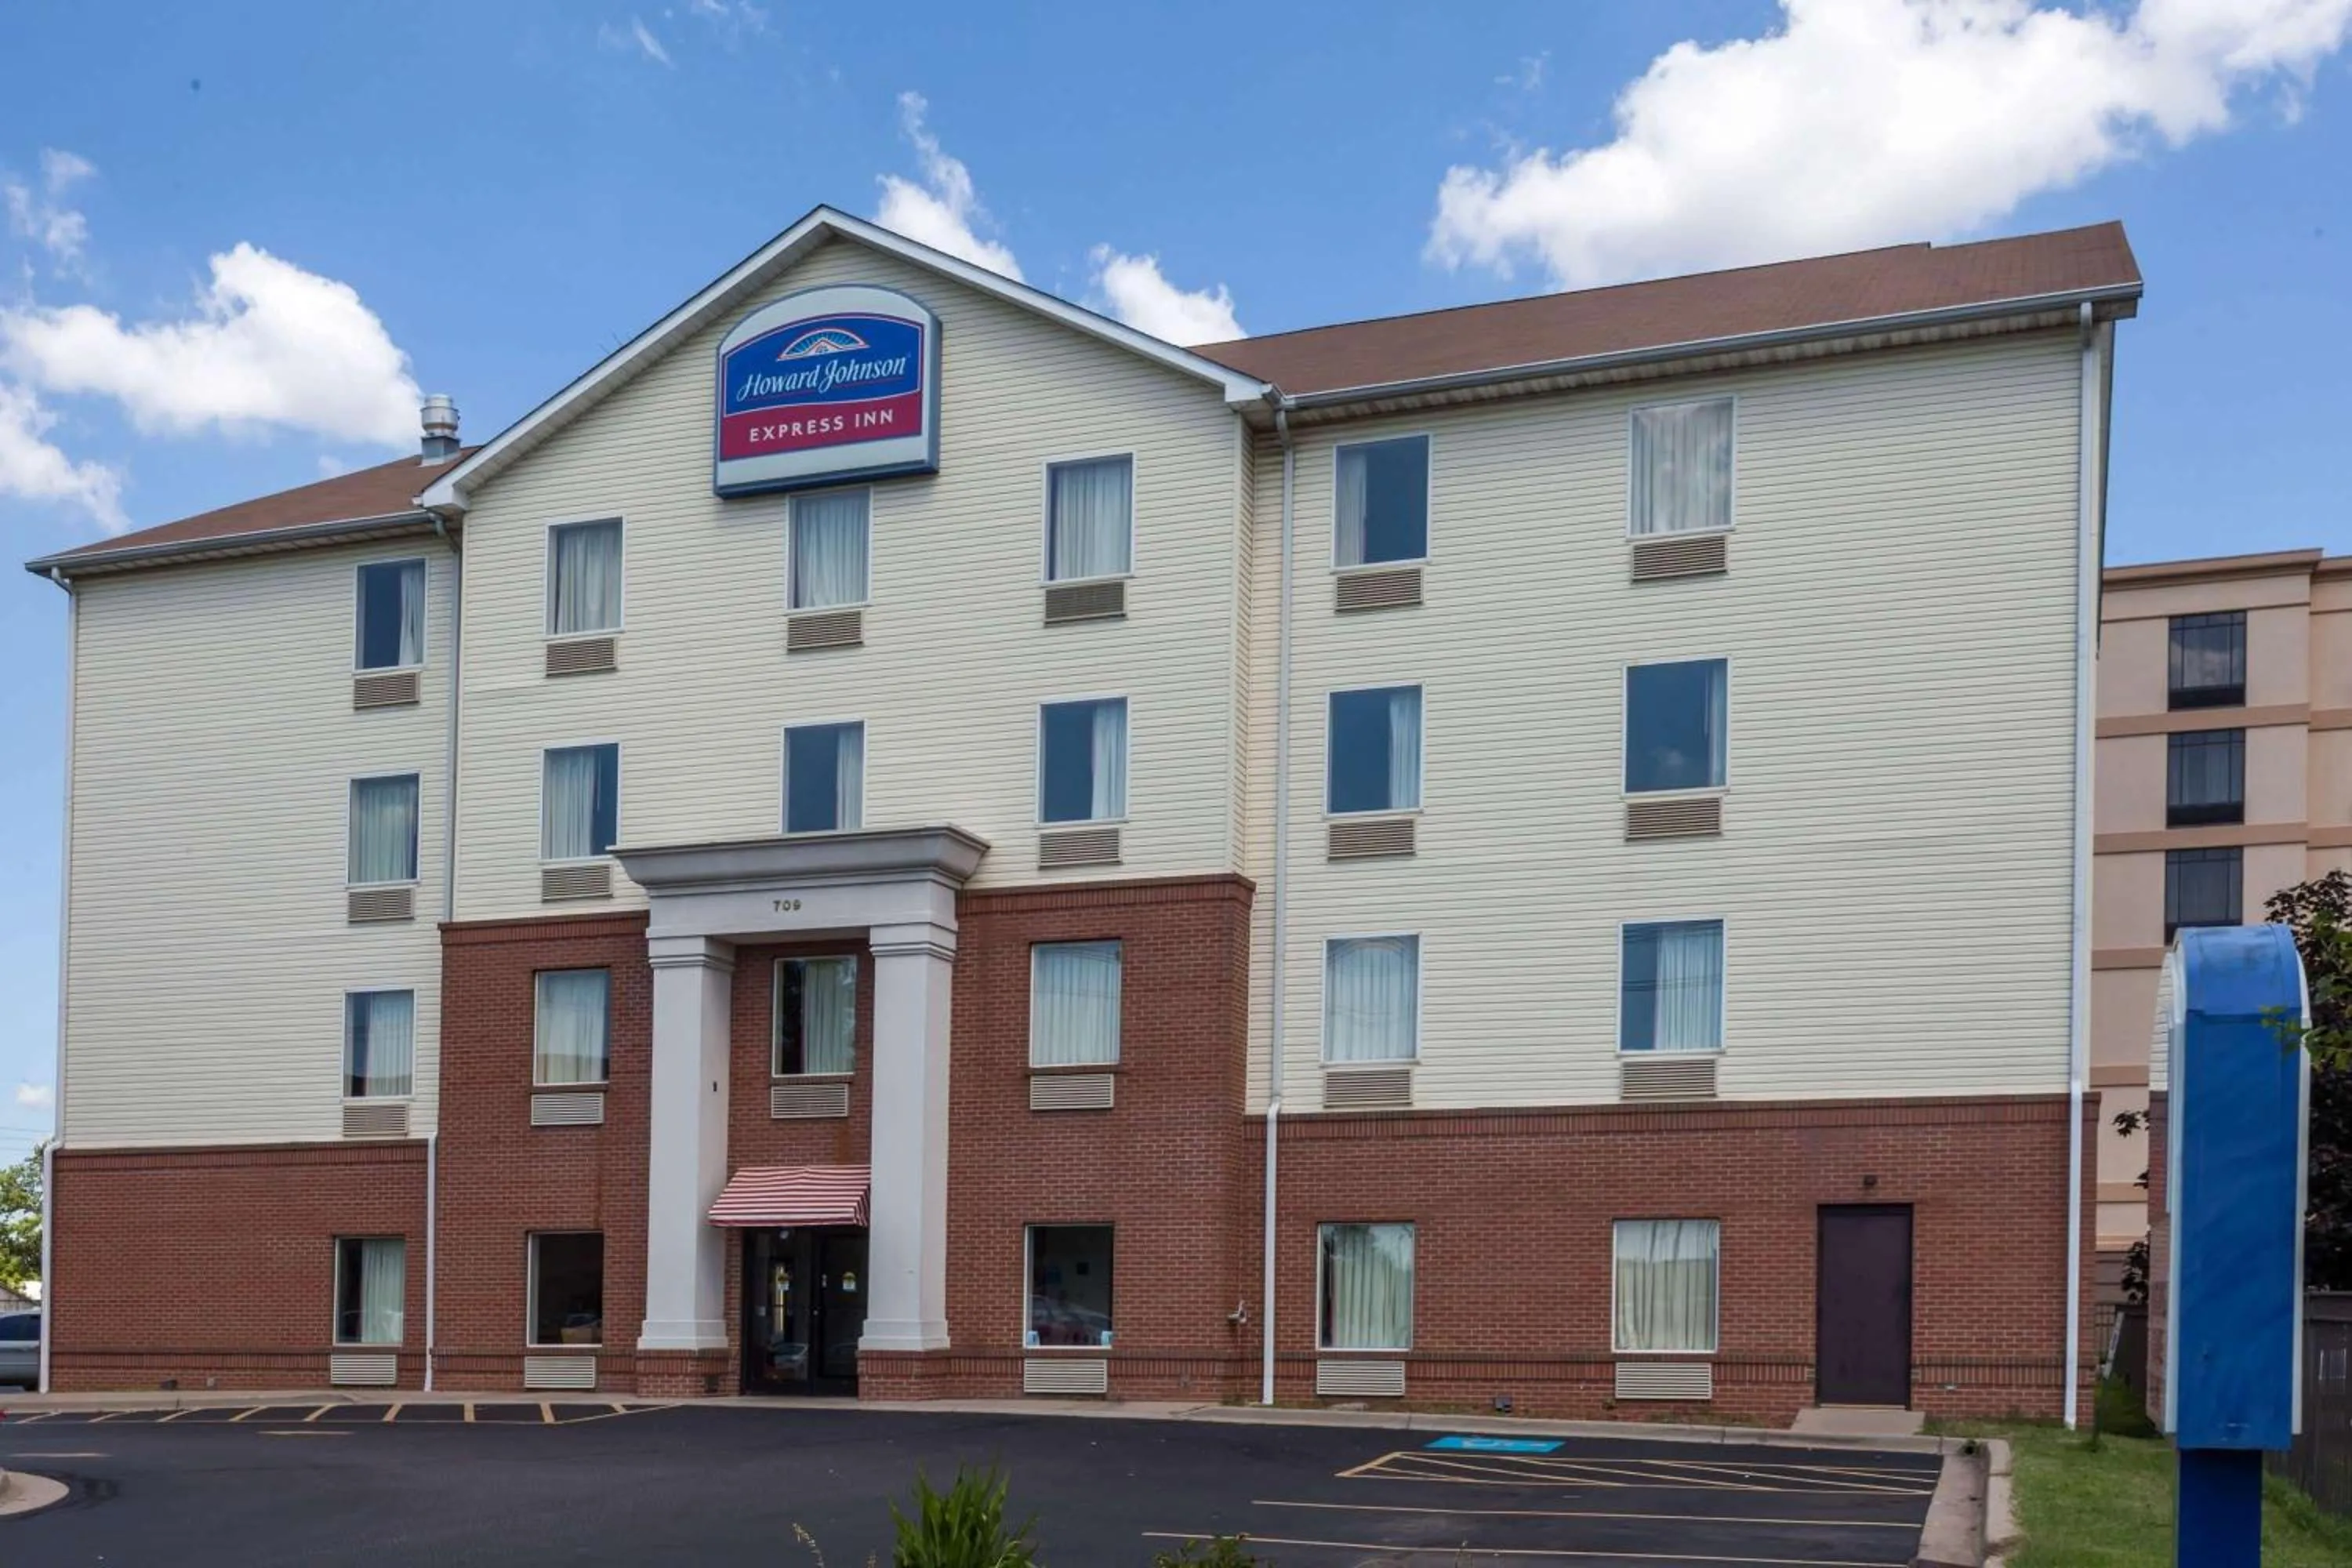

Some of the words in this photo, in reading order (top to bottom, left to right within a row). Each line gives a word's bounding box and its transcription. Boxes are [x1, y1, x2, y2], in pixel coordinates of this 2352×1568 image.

[737, 365, 820, 401] Howard
[818, 356, 906, 393] Johnson
[750, 416, 844, 442] EXPRESS
[855, 409, 894, 428] INN
[773, 899, 801, 912] 709
